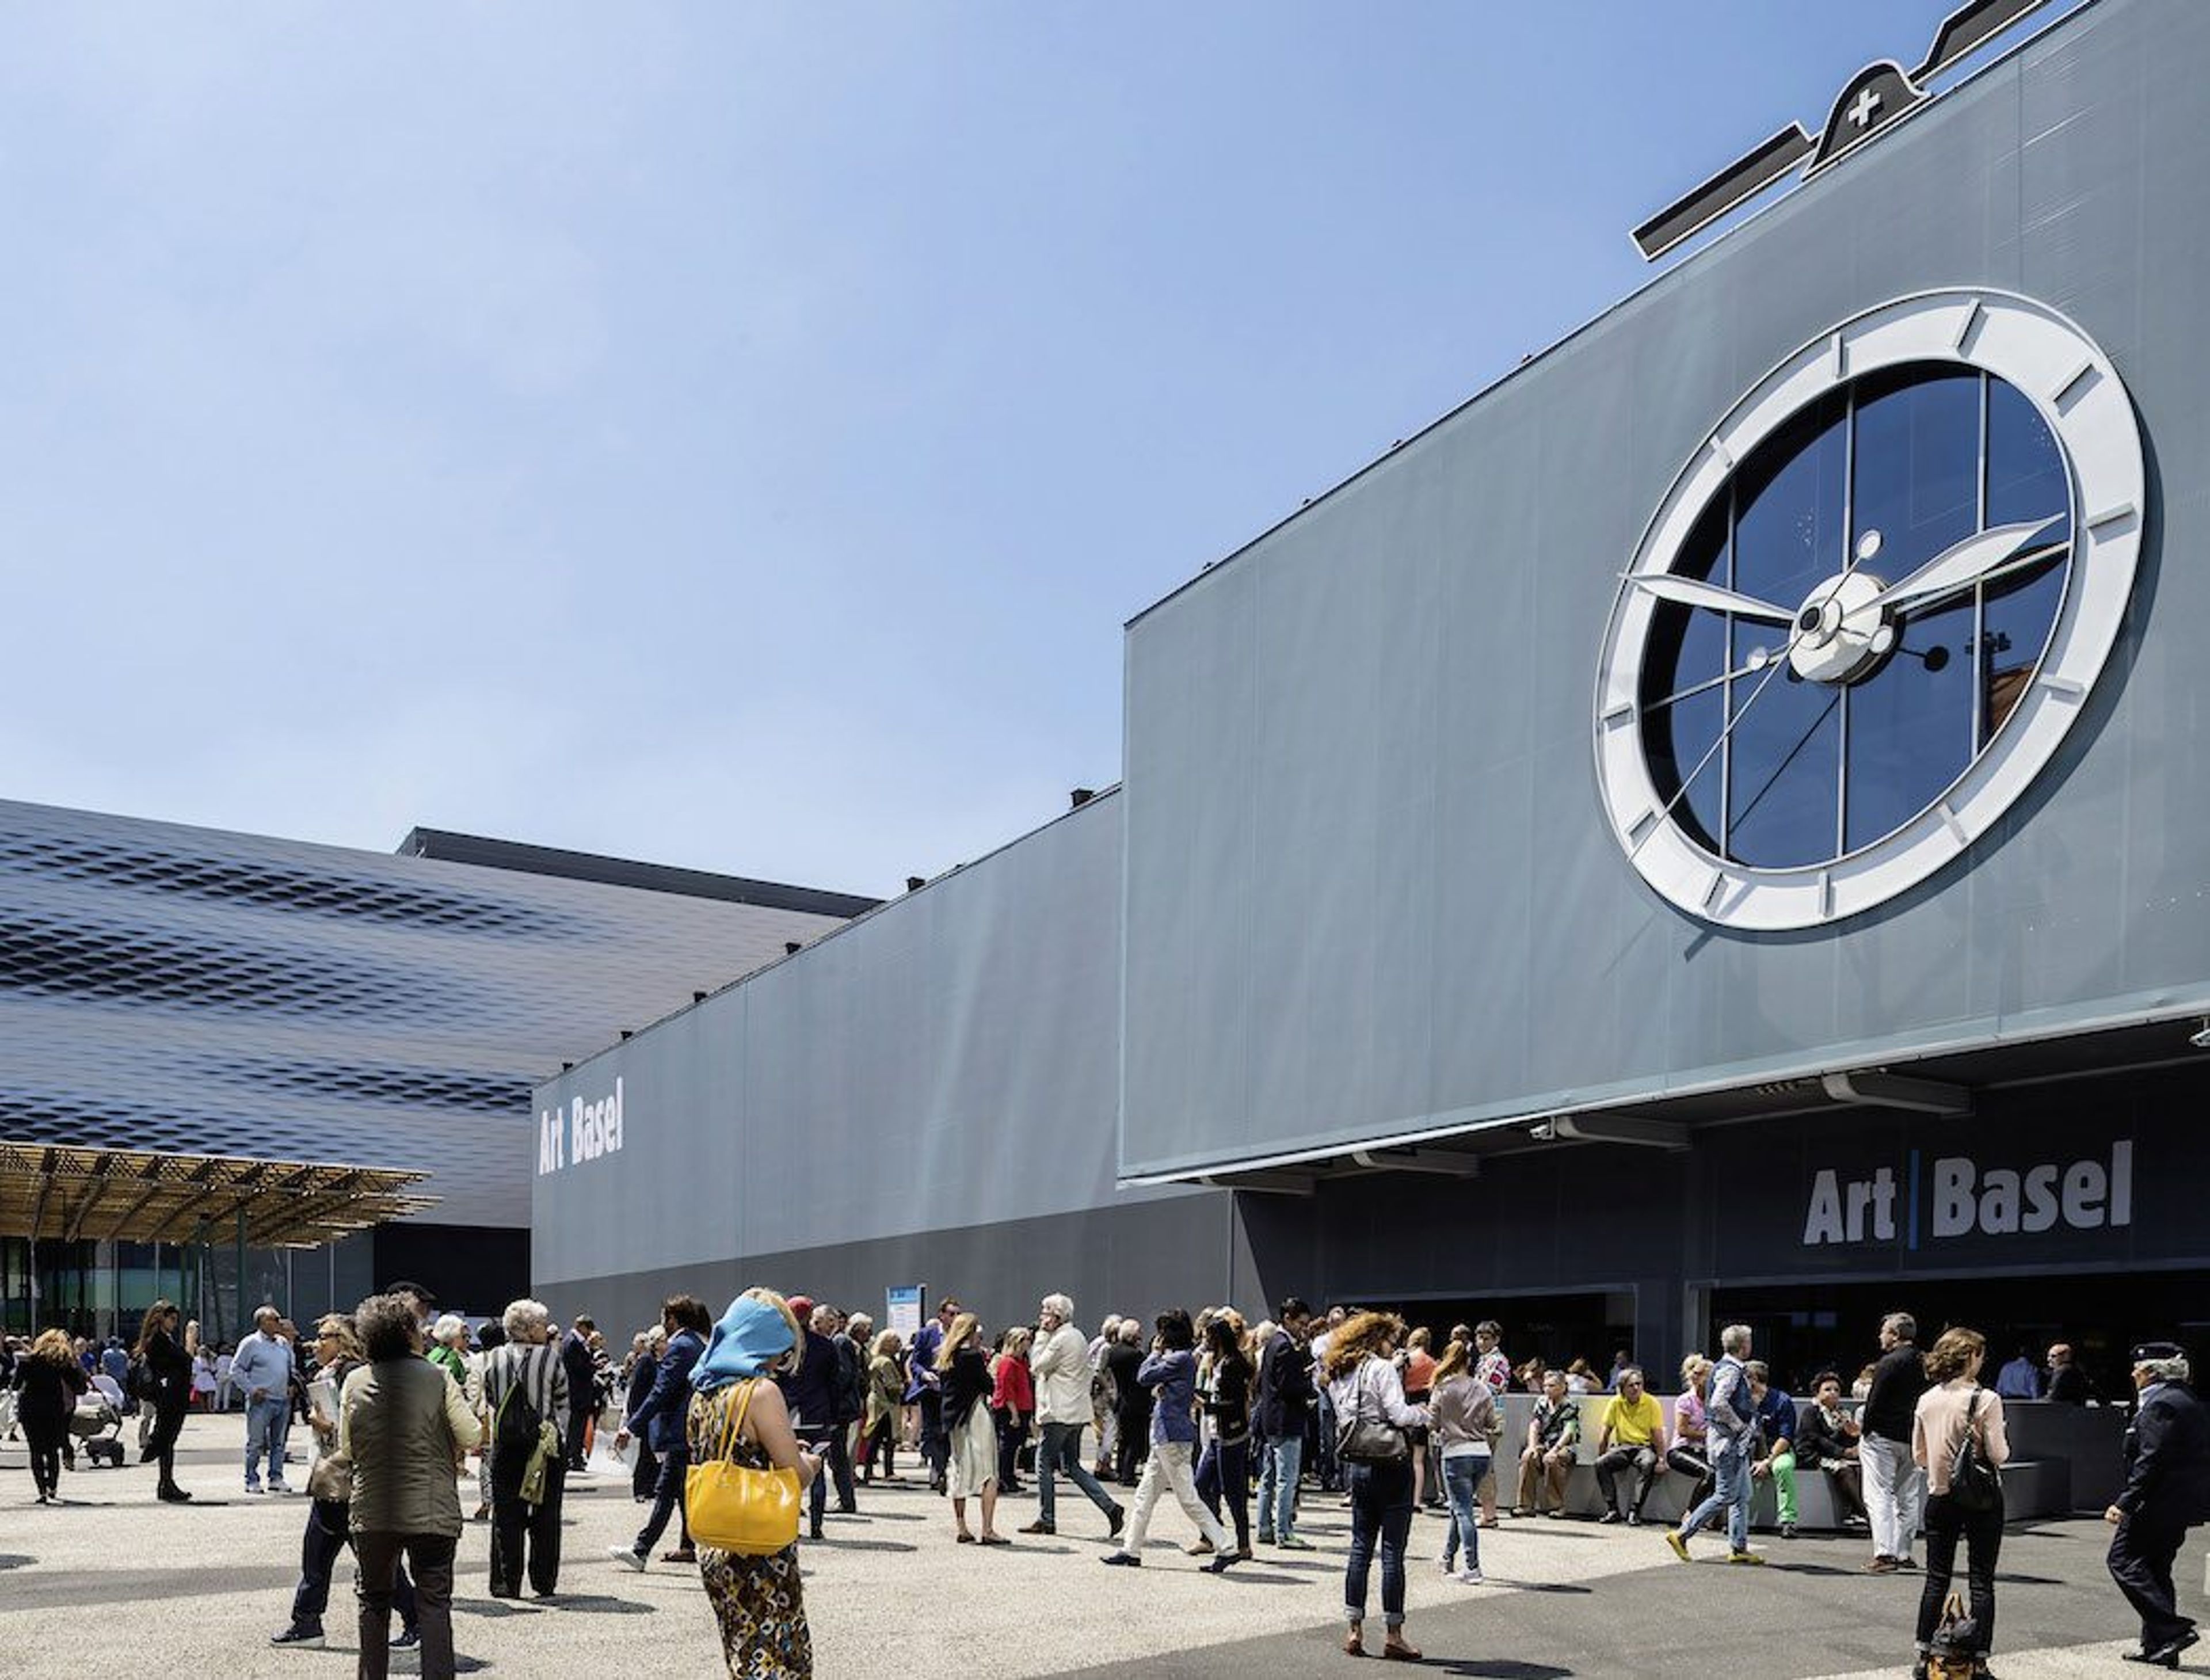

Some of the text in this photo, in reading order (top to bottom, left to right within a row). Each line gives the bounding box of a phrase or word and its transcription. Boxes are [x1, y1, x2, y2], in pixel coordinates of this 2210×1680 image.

[540, 1076, 622, 1175] Art Basel
[1803, 1140, 2133, 1245] Art Basel
